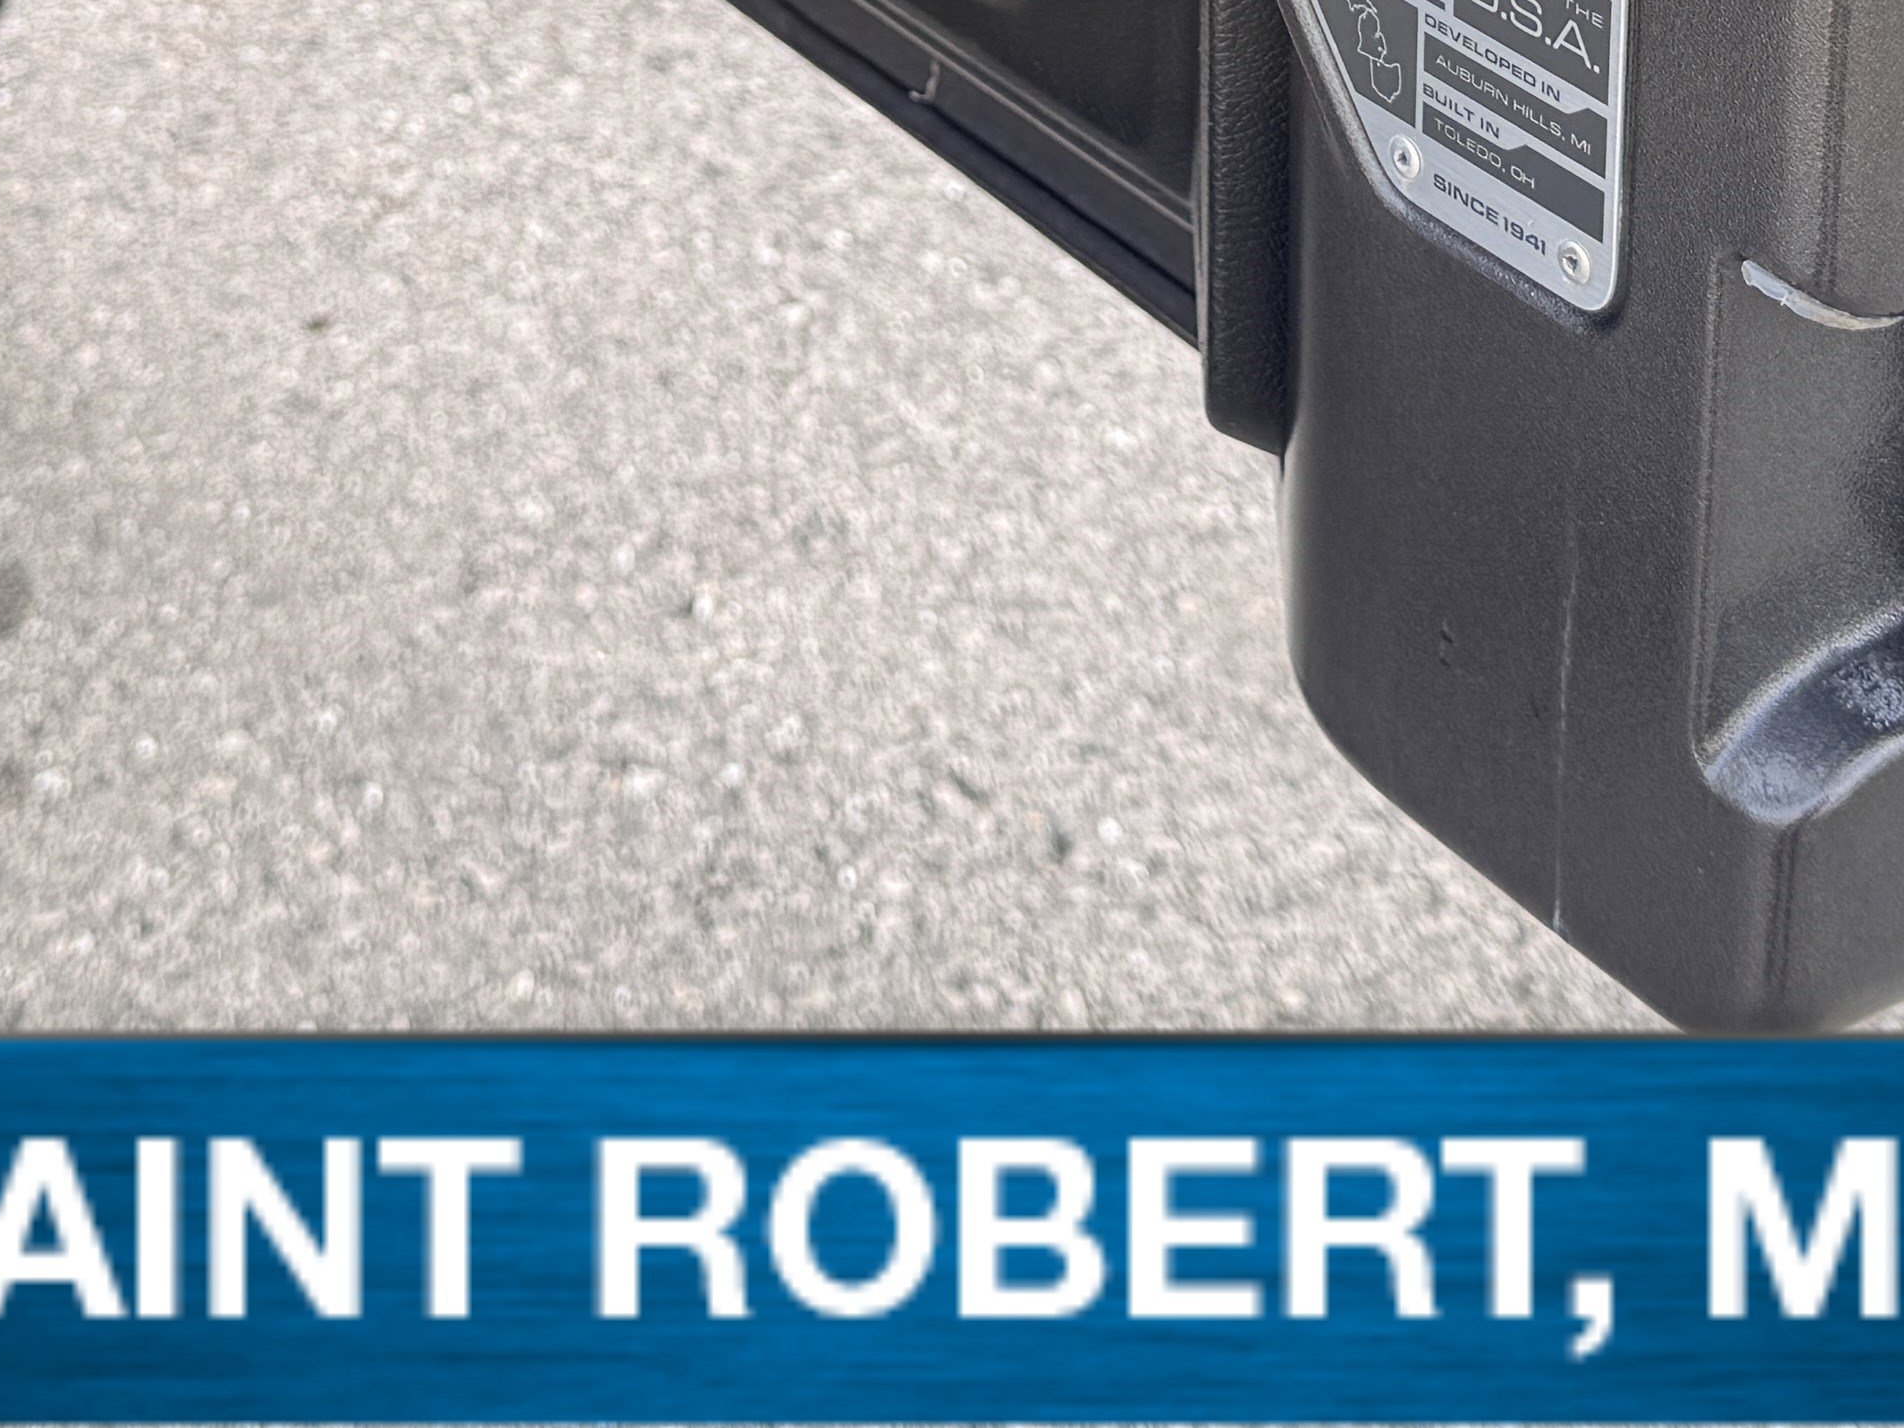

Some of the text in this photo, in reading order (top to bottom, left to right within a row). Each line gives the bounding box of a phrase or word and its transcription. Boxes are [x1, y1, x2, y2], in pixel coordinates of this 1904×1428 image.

[1424, 12, 1561, 102] DEVELOPED IN
[1422, 82, 1500, 139] BUILT IN
[1435, 54, 1509, 106] AUBURN
[1570, 134, 1592, 156] MI
[1432, 172, 1547, 256] SINCE 1941
[1510, 163, 1536, 190] OH
